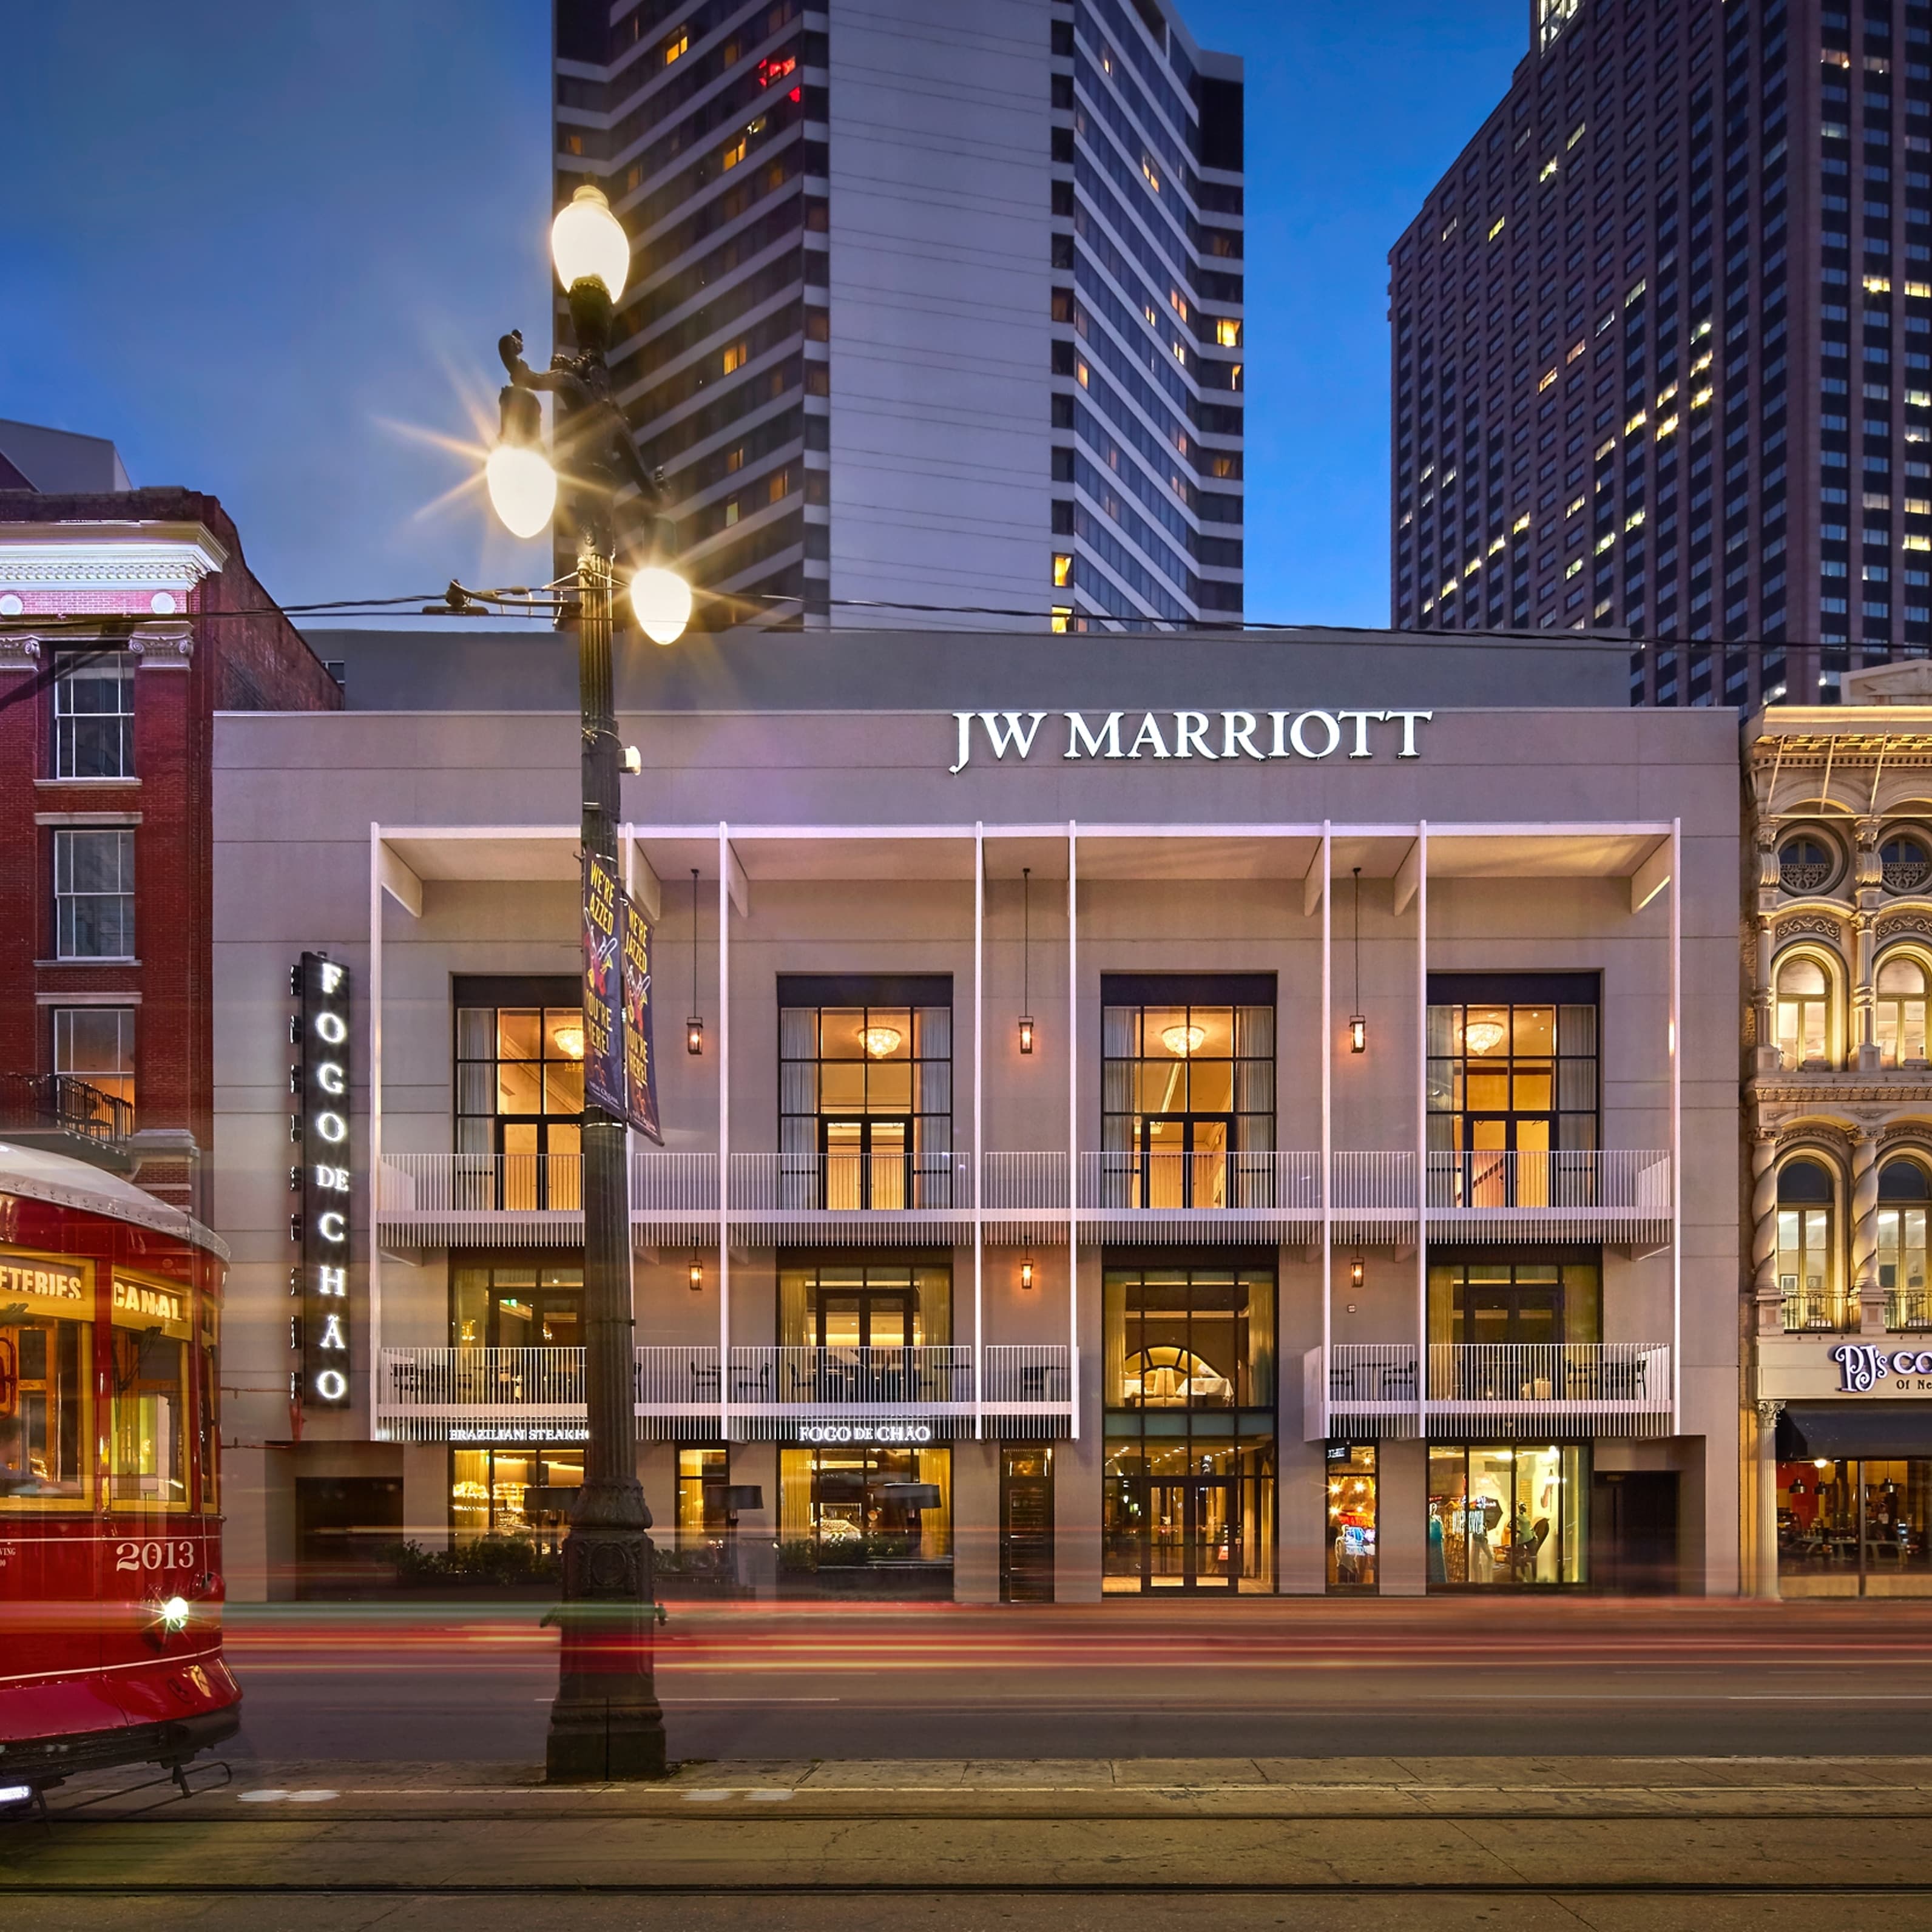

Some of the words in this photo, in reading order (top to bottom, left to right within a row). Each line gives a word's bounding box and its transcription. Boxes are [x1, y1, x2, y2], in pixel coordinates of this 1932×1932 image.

[948, 711, 1047, 775] JW
[1063, 711, 1433, 760] MARRIOTT
[590, 860, 615, 908] WE'RE
[628, 905, 648, 947] WE'RE
[624, 931, 647, 974] JAZZED
[316, 962, 346, 1142] FOGO
[316, 1164, 350, 1192] DE
[113, 1281, 182, 1321] CANAL
[316, 1213, 346, 1400] CHÃO
[1834, 1344, 1888, 1392] PJ's
[1896, 1379, 1910, 1390] Of
[449, 1430, 524, 1441] BRAZILIAN
[799, 1426, 851, 1441] FOGO
[853, 1427, 873, 1440] DE
[116, 1541, 194, 1572] 2013
